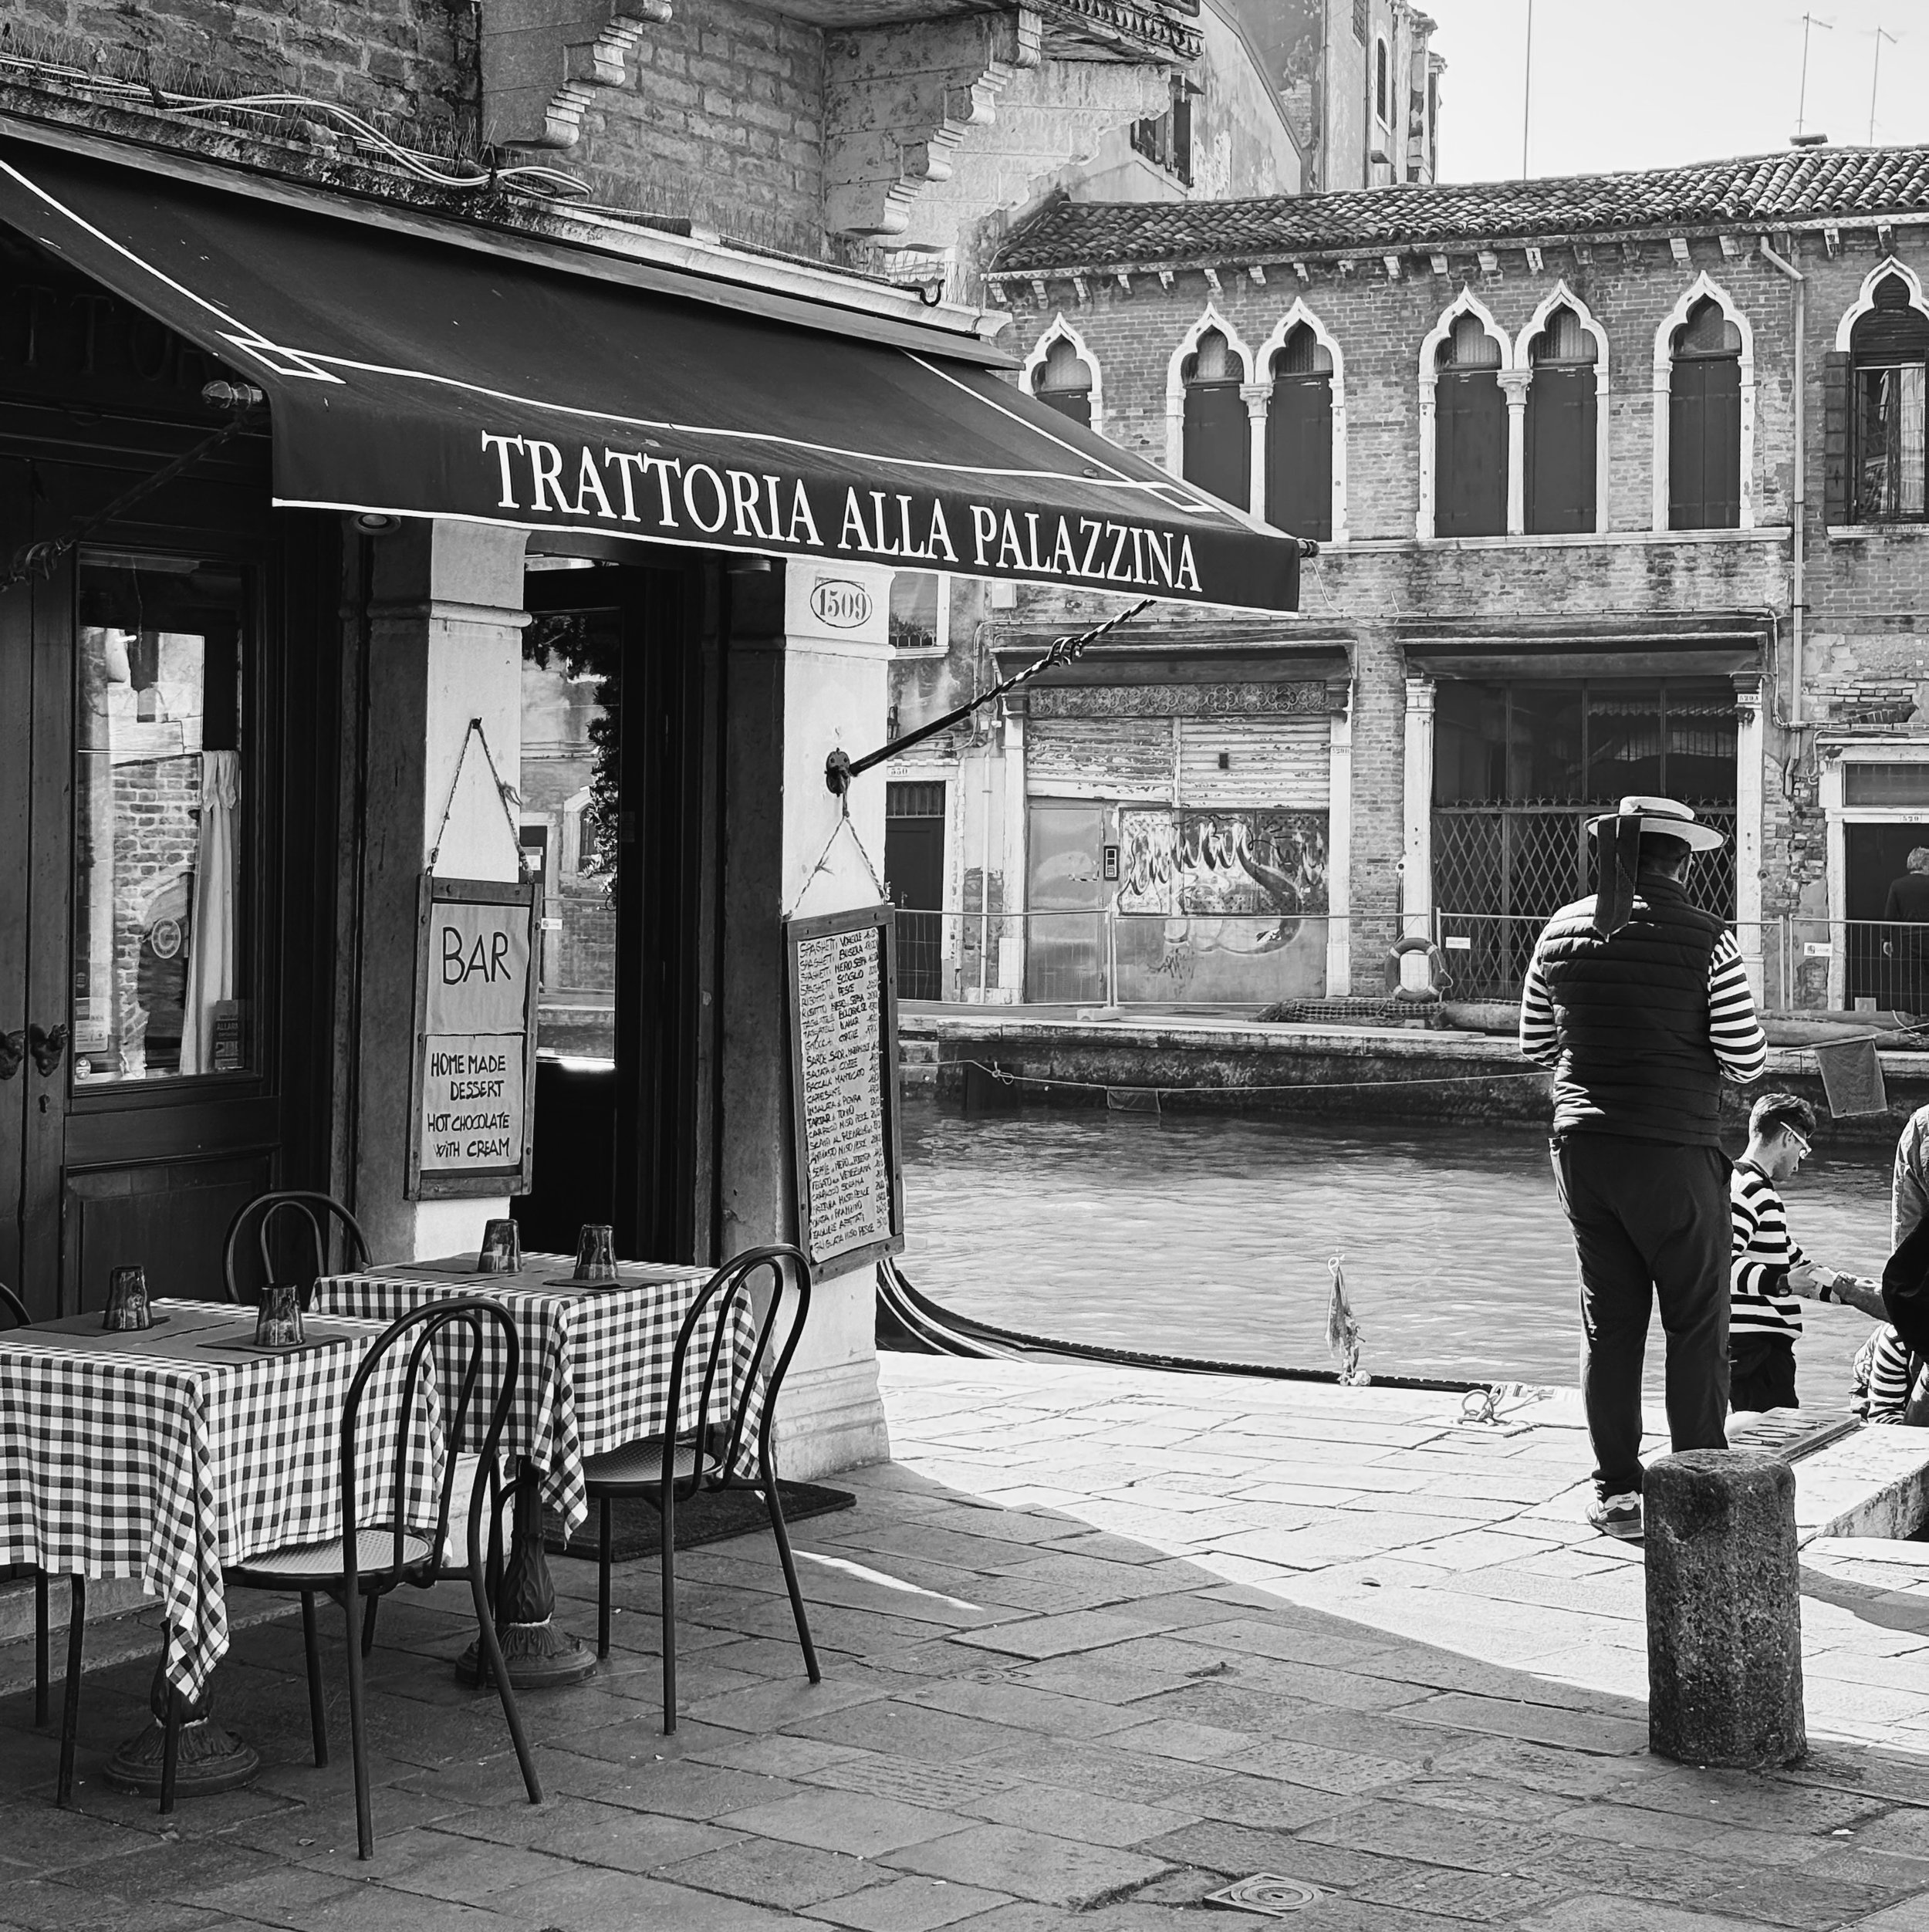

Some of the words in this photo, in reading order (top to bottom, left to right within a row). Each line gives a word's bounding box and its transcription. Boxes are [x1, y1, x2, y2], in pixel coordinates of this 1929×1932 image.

[481, 429, 824, 546] TRATTORIA
[837, 486, 958, 562] ALLA
[969, 505, 1203, 593] PALAZZINA
[819, 589, 867, 620] 1509
[443, 927, 511, 985] BAR
[431, 1053, 465, 1077] HOME
[468, 1054, 506, 1075] MADE
[450, 1080, 504, 1101] DESSERT
[427, 1113, 451, 1133] HOT
[451, 1111, 510, 1133] CHOCOLATE
[467, 1138, 510, 1157] CREAM
